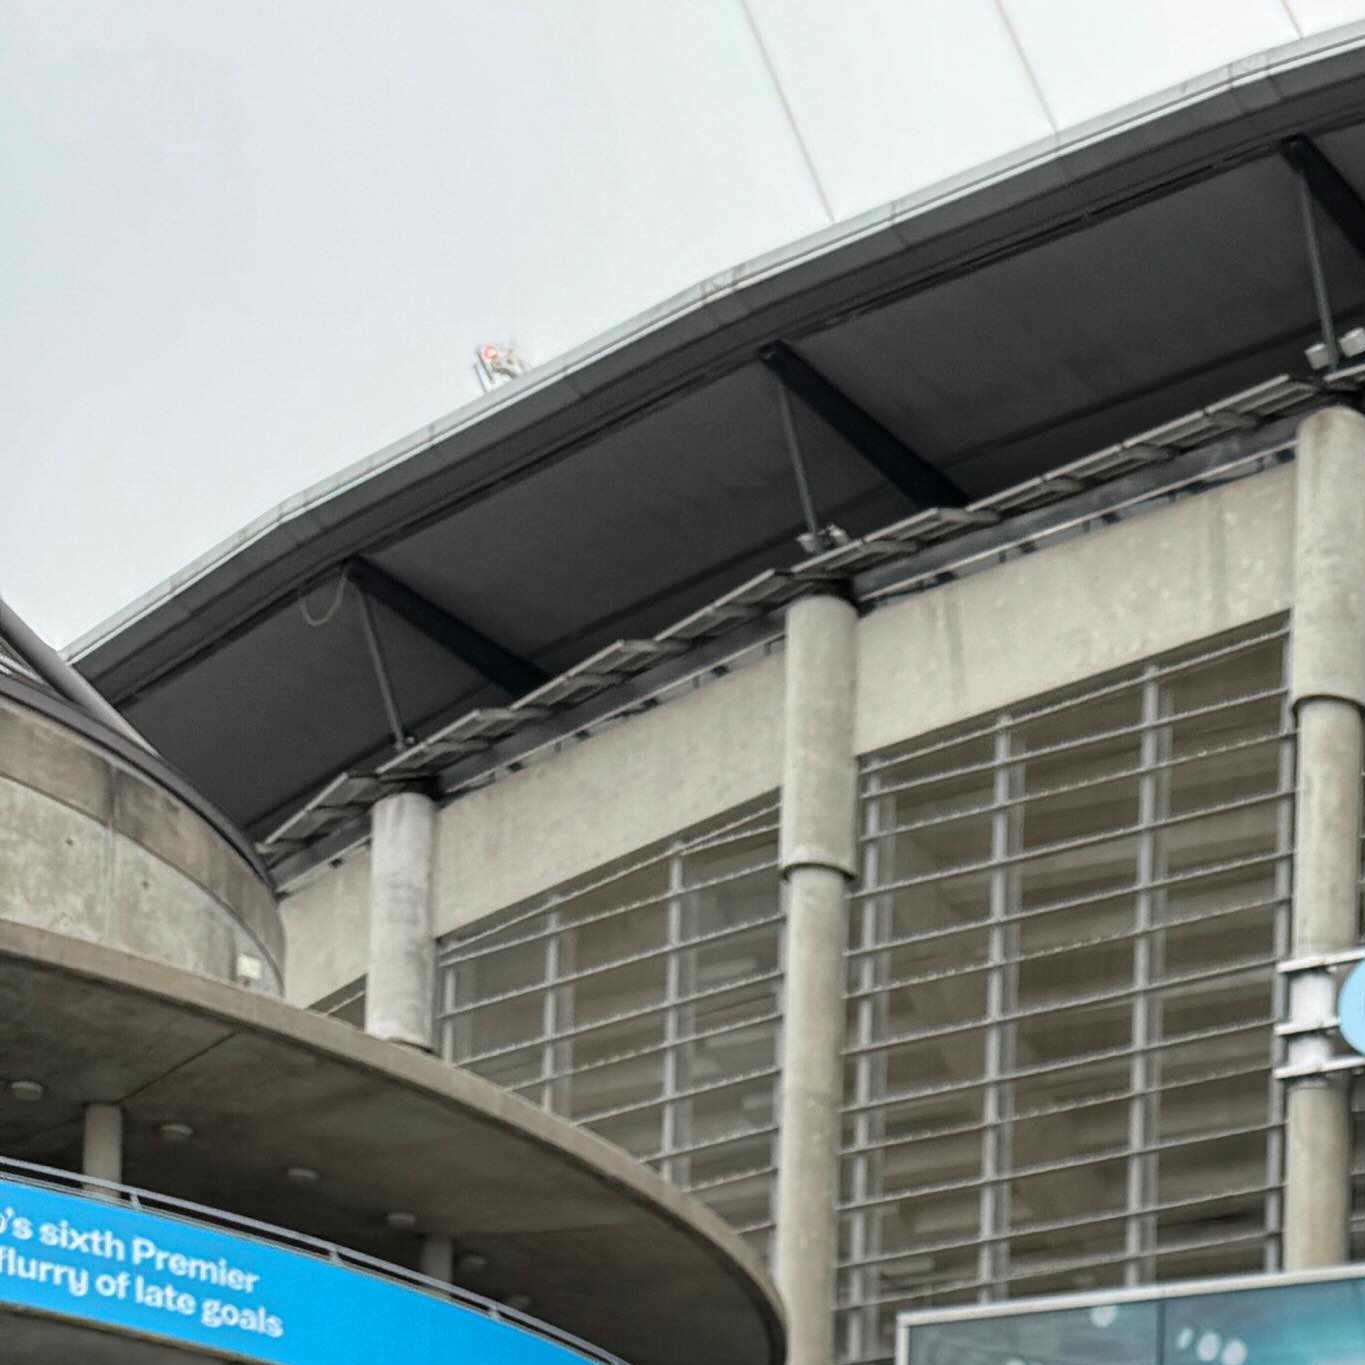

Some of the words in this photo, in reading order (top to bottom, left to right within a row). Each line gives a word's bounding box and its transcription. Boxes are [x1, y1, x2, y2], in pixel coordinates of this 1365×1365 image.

[38, 1219, 125, 1262] sixth
[131, 1237, 260, 1294] Premier
[95, 1271, 130, 1300] of
[135, 1275, 197, 1316] late
[201, 1299, 284, 1338] goals
